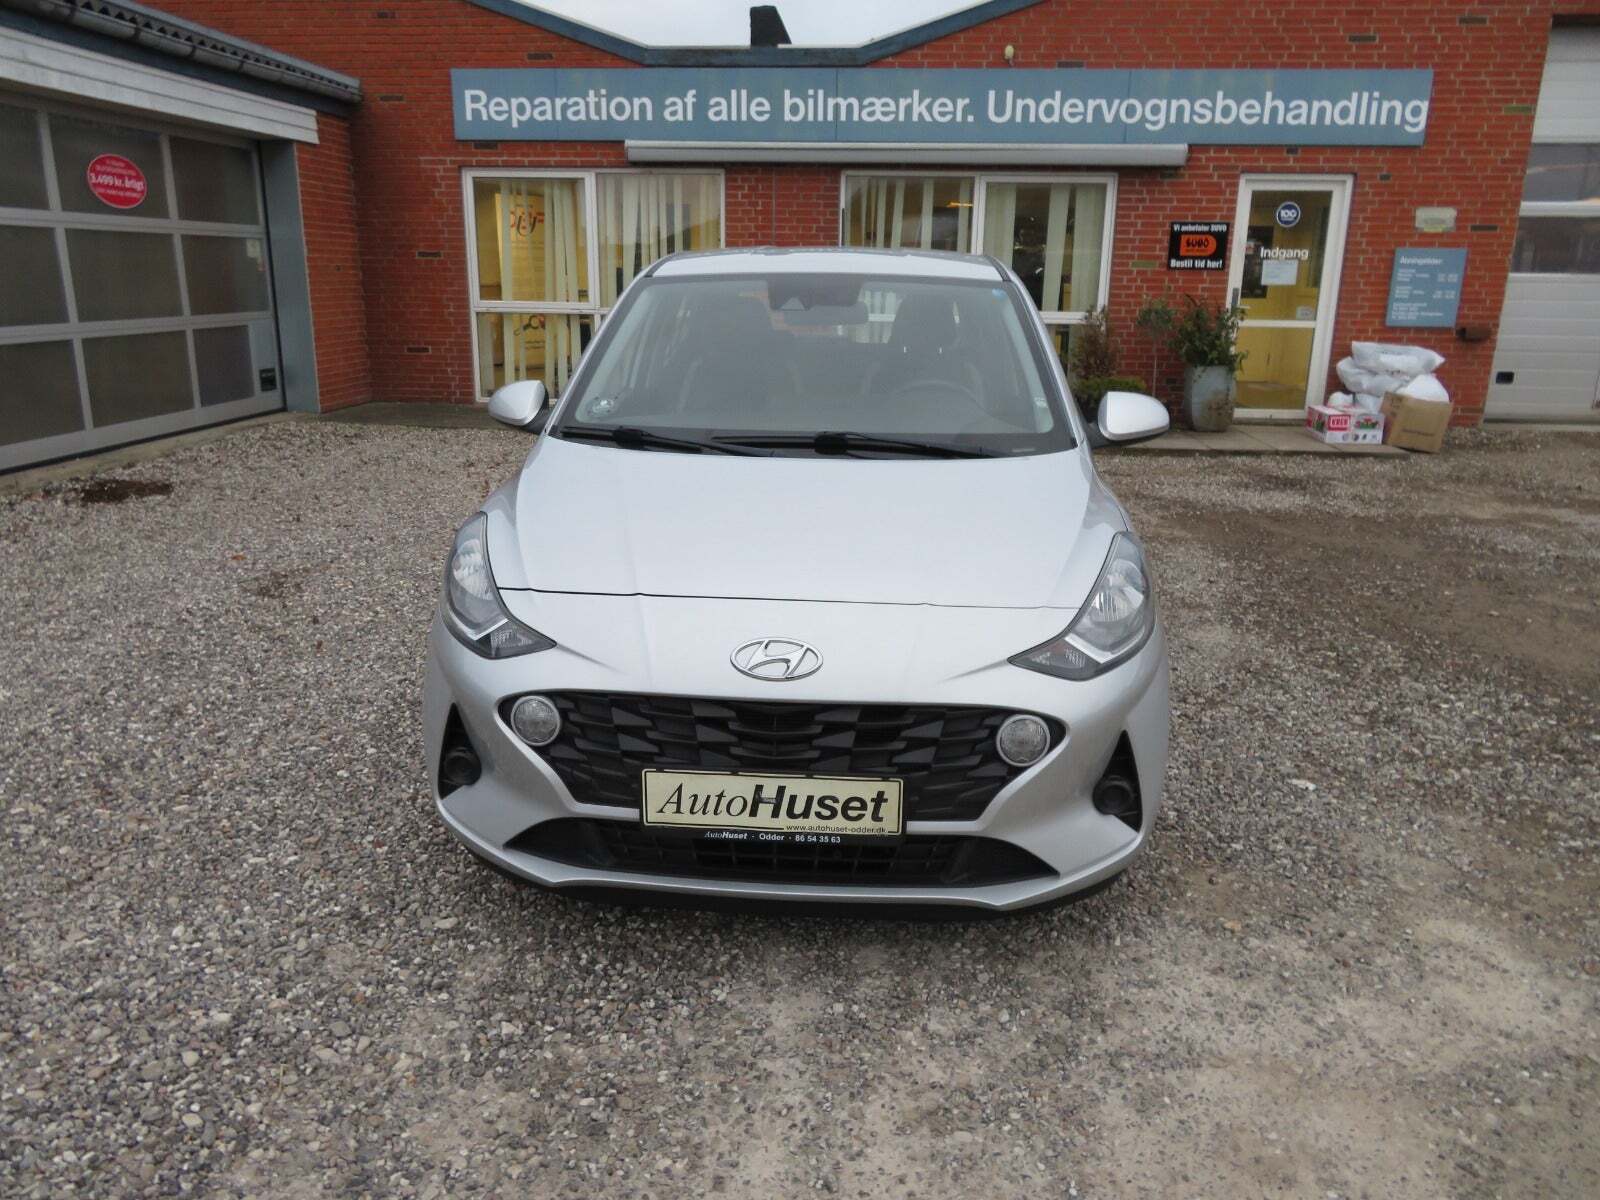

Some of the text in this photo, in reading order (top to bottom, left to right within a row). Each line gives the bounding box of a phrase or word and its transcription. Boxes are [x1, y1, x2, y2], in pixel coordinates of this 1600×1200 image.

[463, 88, 1428, 133] Reparation af alle bilmærker. Undervognsbehandling
[1261, 246, 1309, 261] Indgang
[1170, 258, 1193, 268] Bestil
[1195, 259, 1205, 268] tid
[656, 783, 888, 822] AutoHuset
[786, 823, 886, 834] www.autohuset-odder.dk
[704, 831, 748, 840] AutoHuset
[758, 833, 785, 842] Odder
[795, 834, 805, 842] 86
[807, 835, 817, 843] 54
[819, 835, 829, 843] 35
[831, 836, 841, 844] 63
